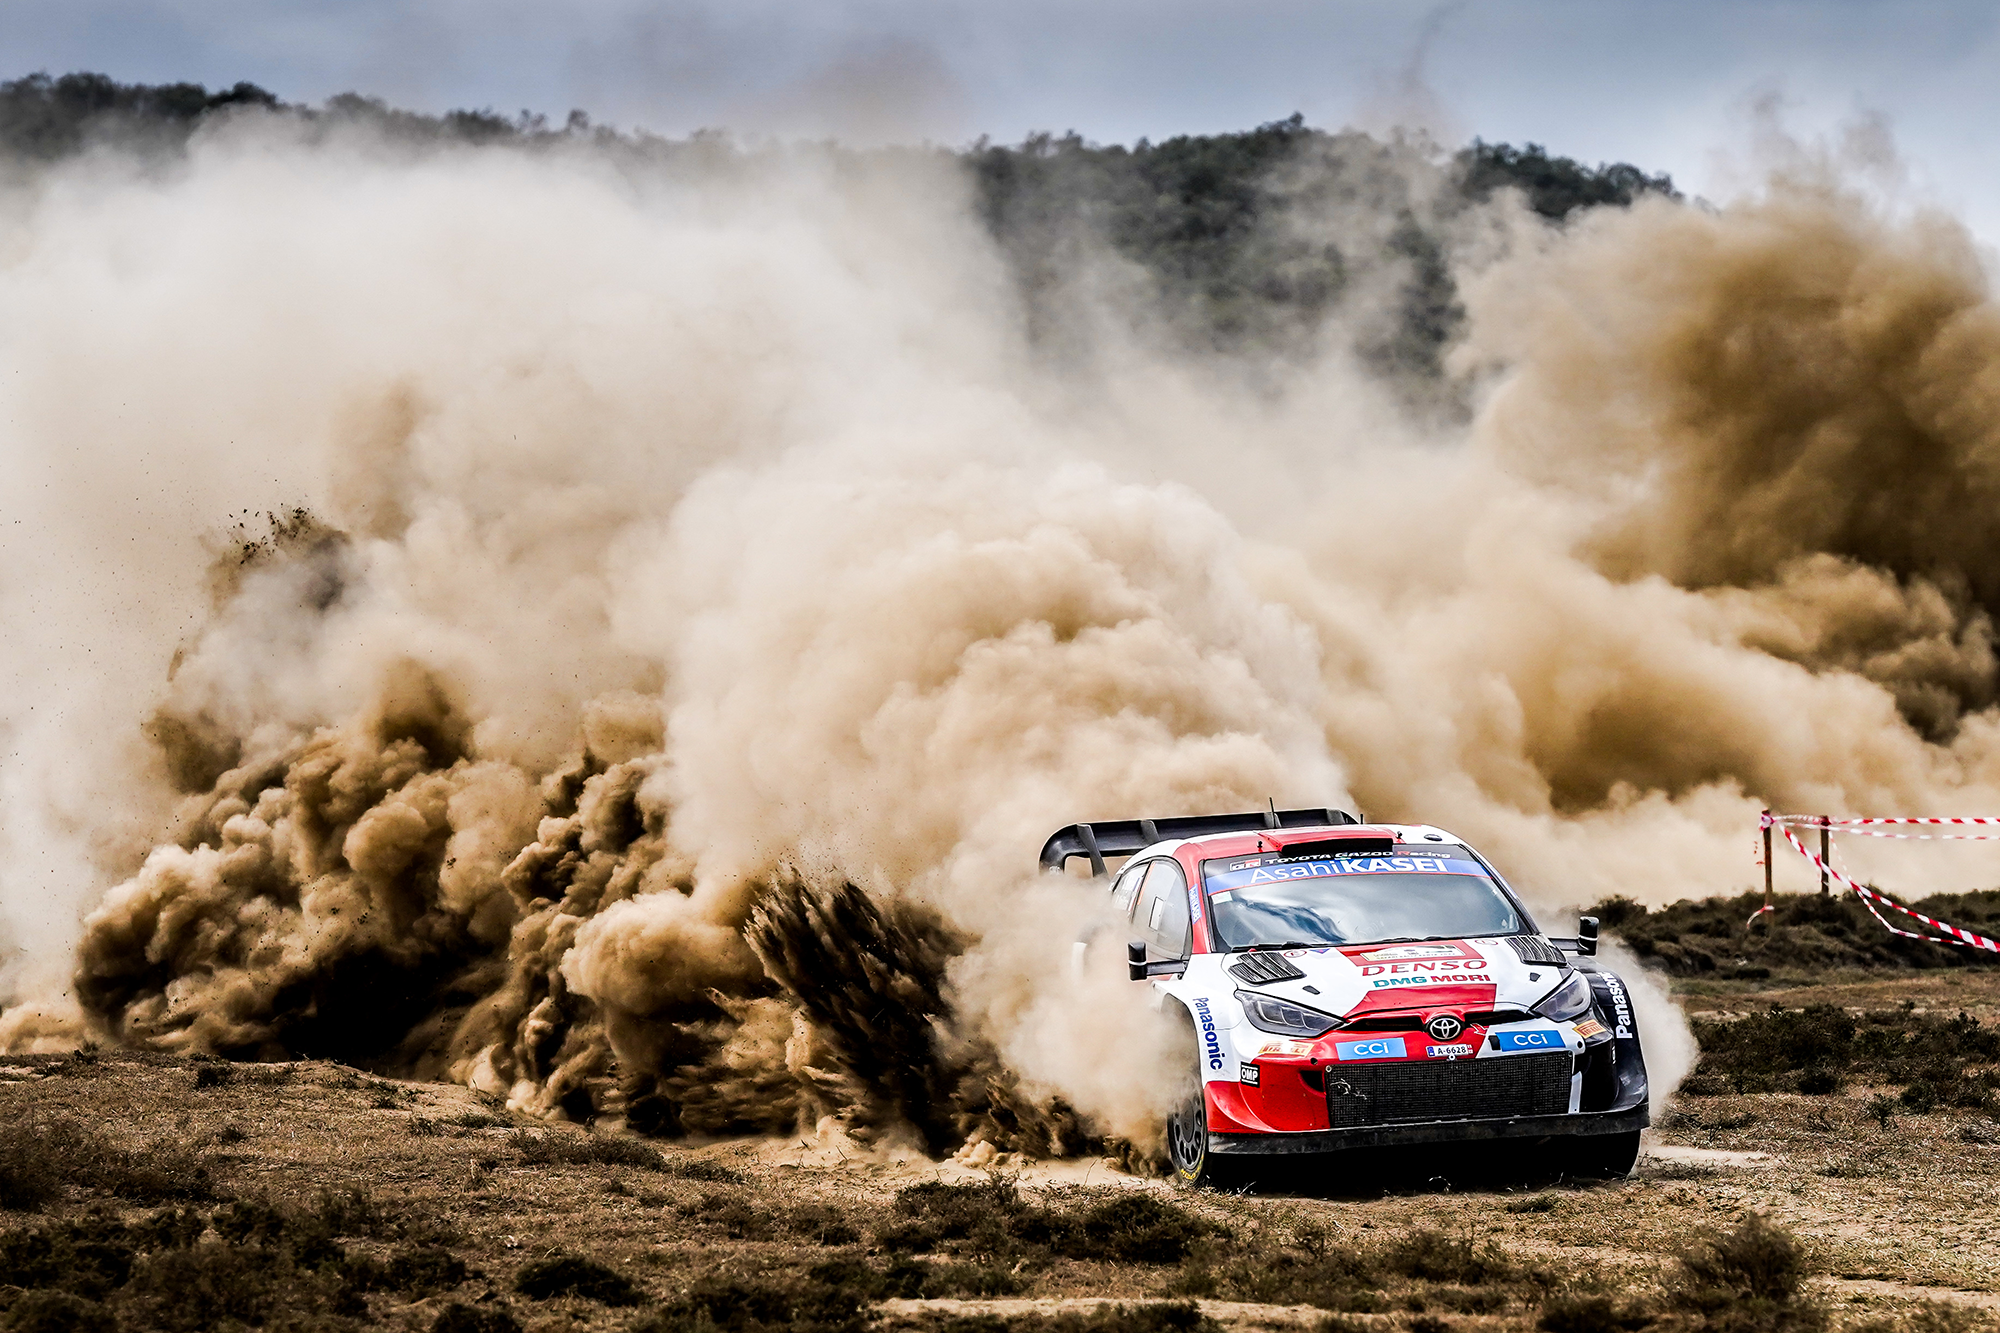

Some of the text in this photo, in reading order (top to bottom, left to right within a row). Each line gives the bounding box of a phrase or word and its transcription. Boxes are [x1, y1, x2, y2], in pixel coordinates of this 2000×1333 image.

[1265, 851, 1451, 865] TOYOTA GAZOO Racing
[1362, 959, 1488, 977] DENSO
[1373, 974, 1491, 988] DMG MORI
[1192, 997, 1226, 1070] Panasonic
[1437, 1045, 1467, 1055] A-6628
[1241, 1068, 1259, 1081] OMP
